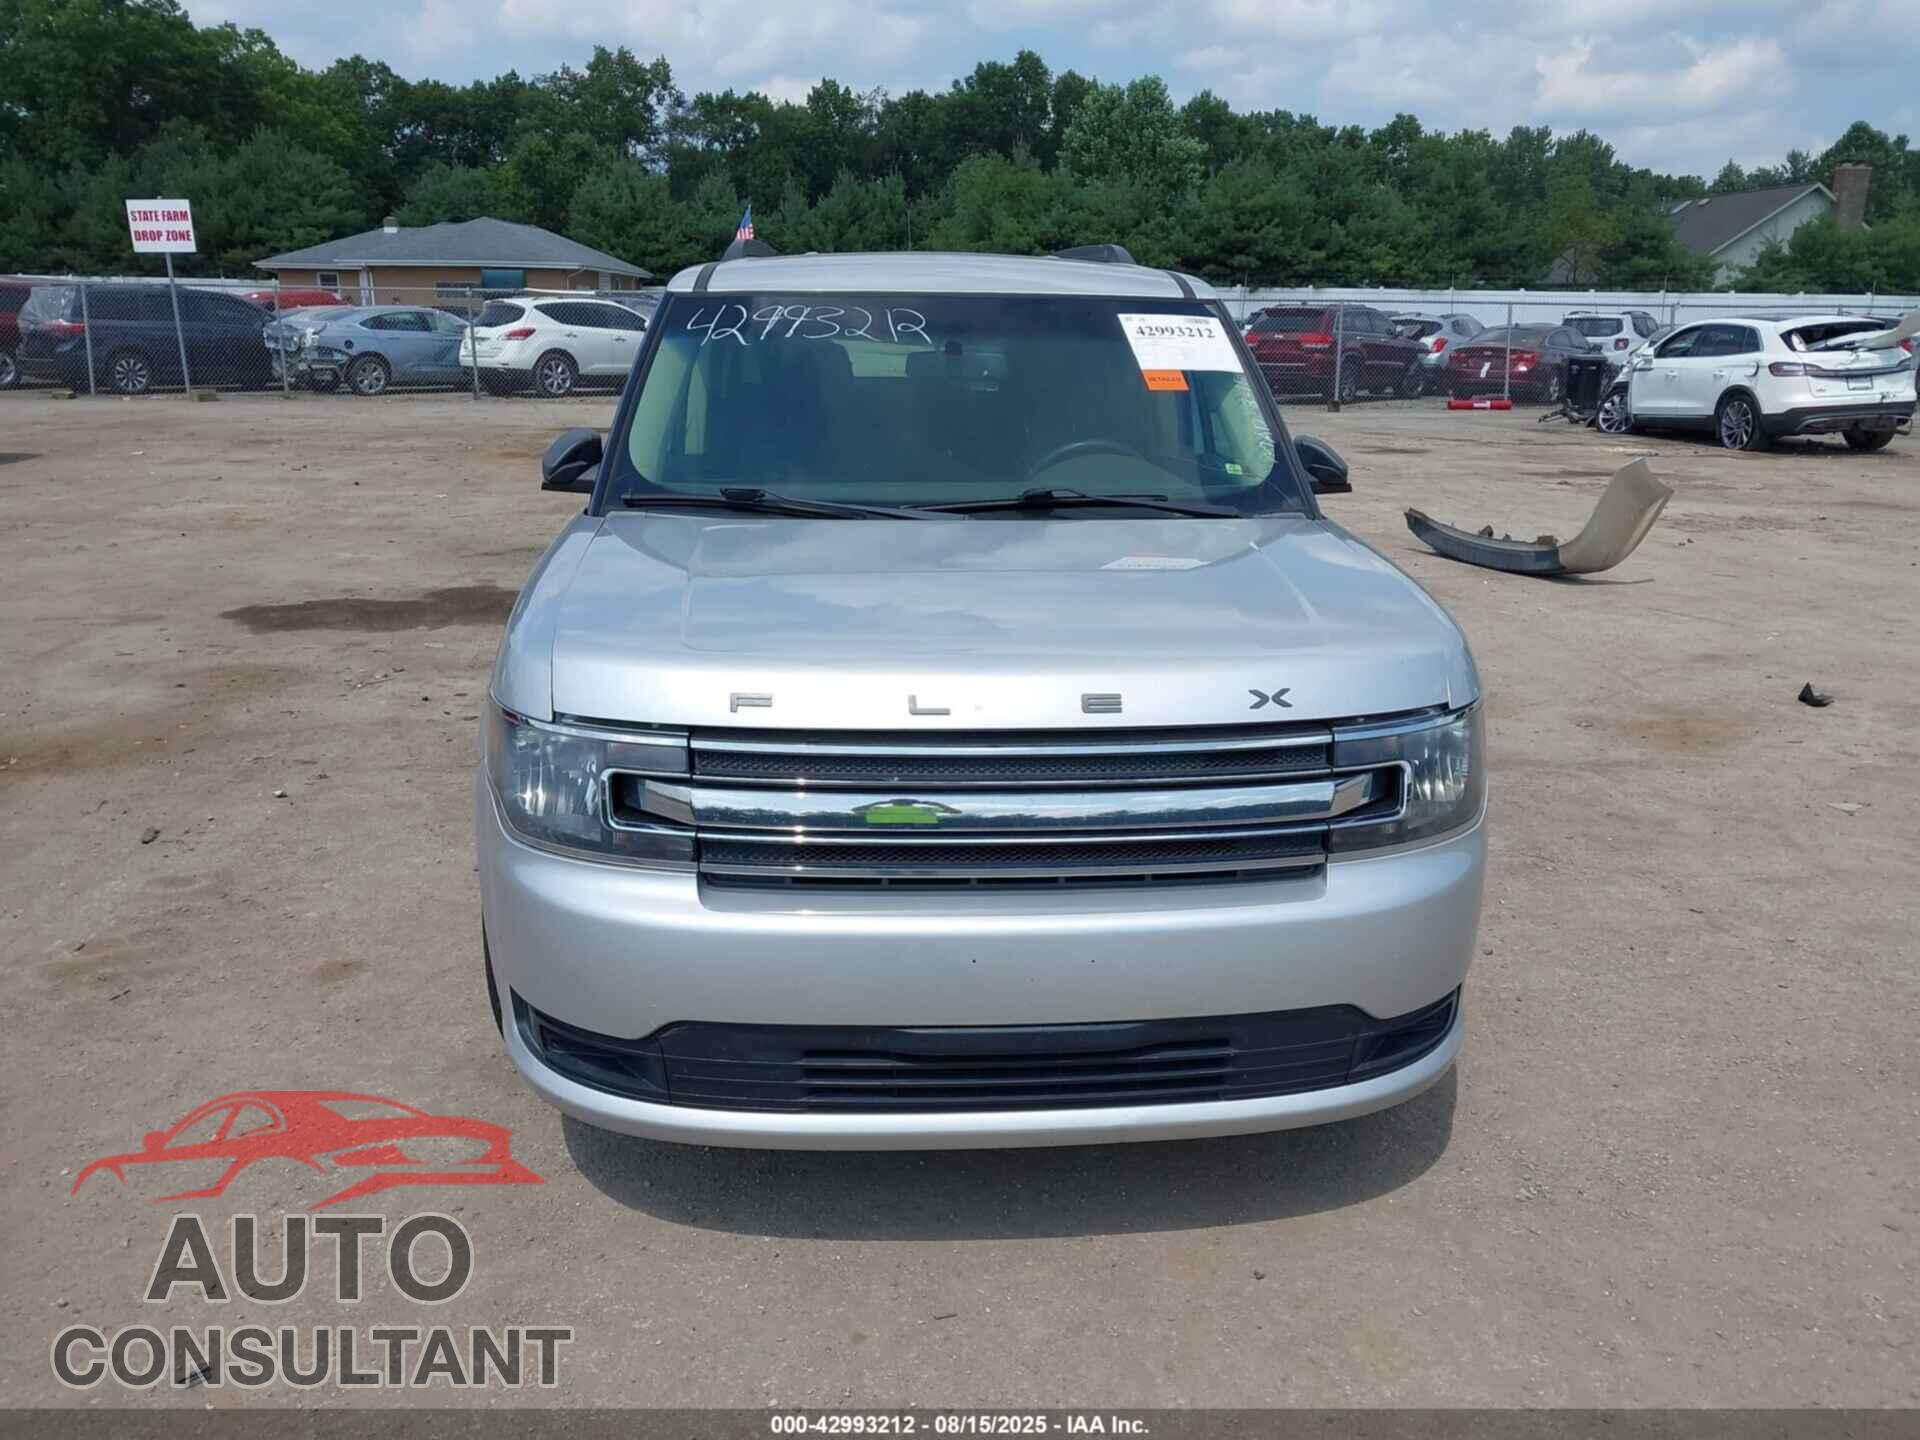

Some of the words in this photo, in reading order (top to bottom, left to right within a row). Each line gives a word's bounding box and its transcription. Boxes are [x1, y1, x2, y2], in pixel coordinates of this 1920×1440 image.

[130, 210, 160, 221] STATE
[162, 210, 189, 221] FARM
[134, 230, 162, 241] DROP
[166, 230, 192, 241] ZONE
[687, 303, 932, 346] 42993212
[1136, 325, 1216, 338] 42993212
